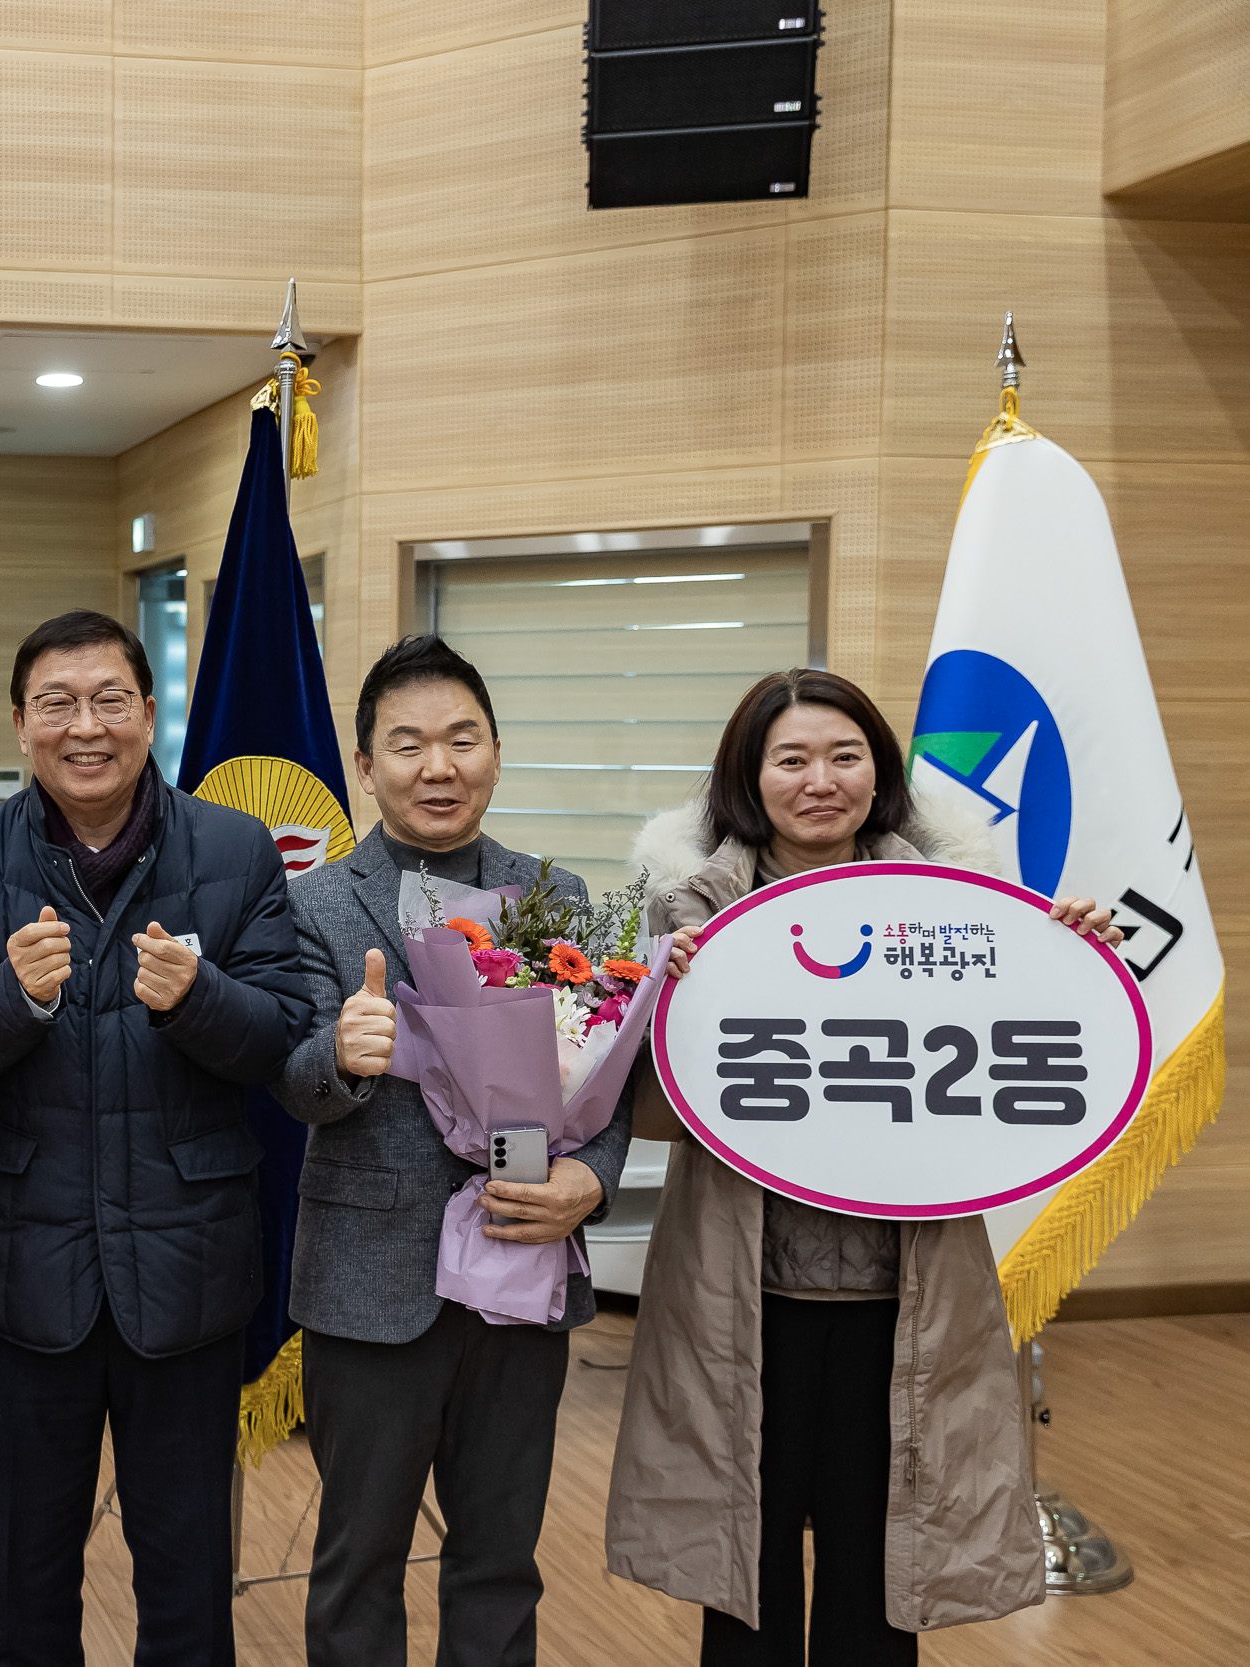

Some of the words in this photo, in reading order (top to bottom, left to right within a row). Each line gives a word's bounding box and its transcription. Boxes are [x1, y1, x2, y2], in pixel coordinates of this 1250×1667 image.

[883, 922, 936, 945] 소통하며
[939, 922, 996, 945] 발전하는
[883, 942, 997, 981] 행복광진
[716, 1018, 1088, 1125] 중곡2동
